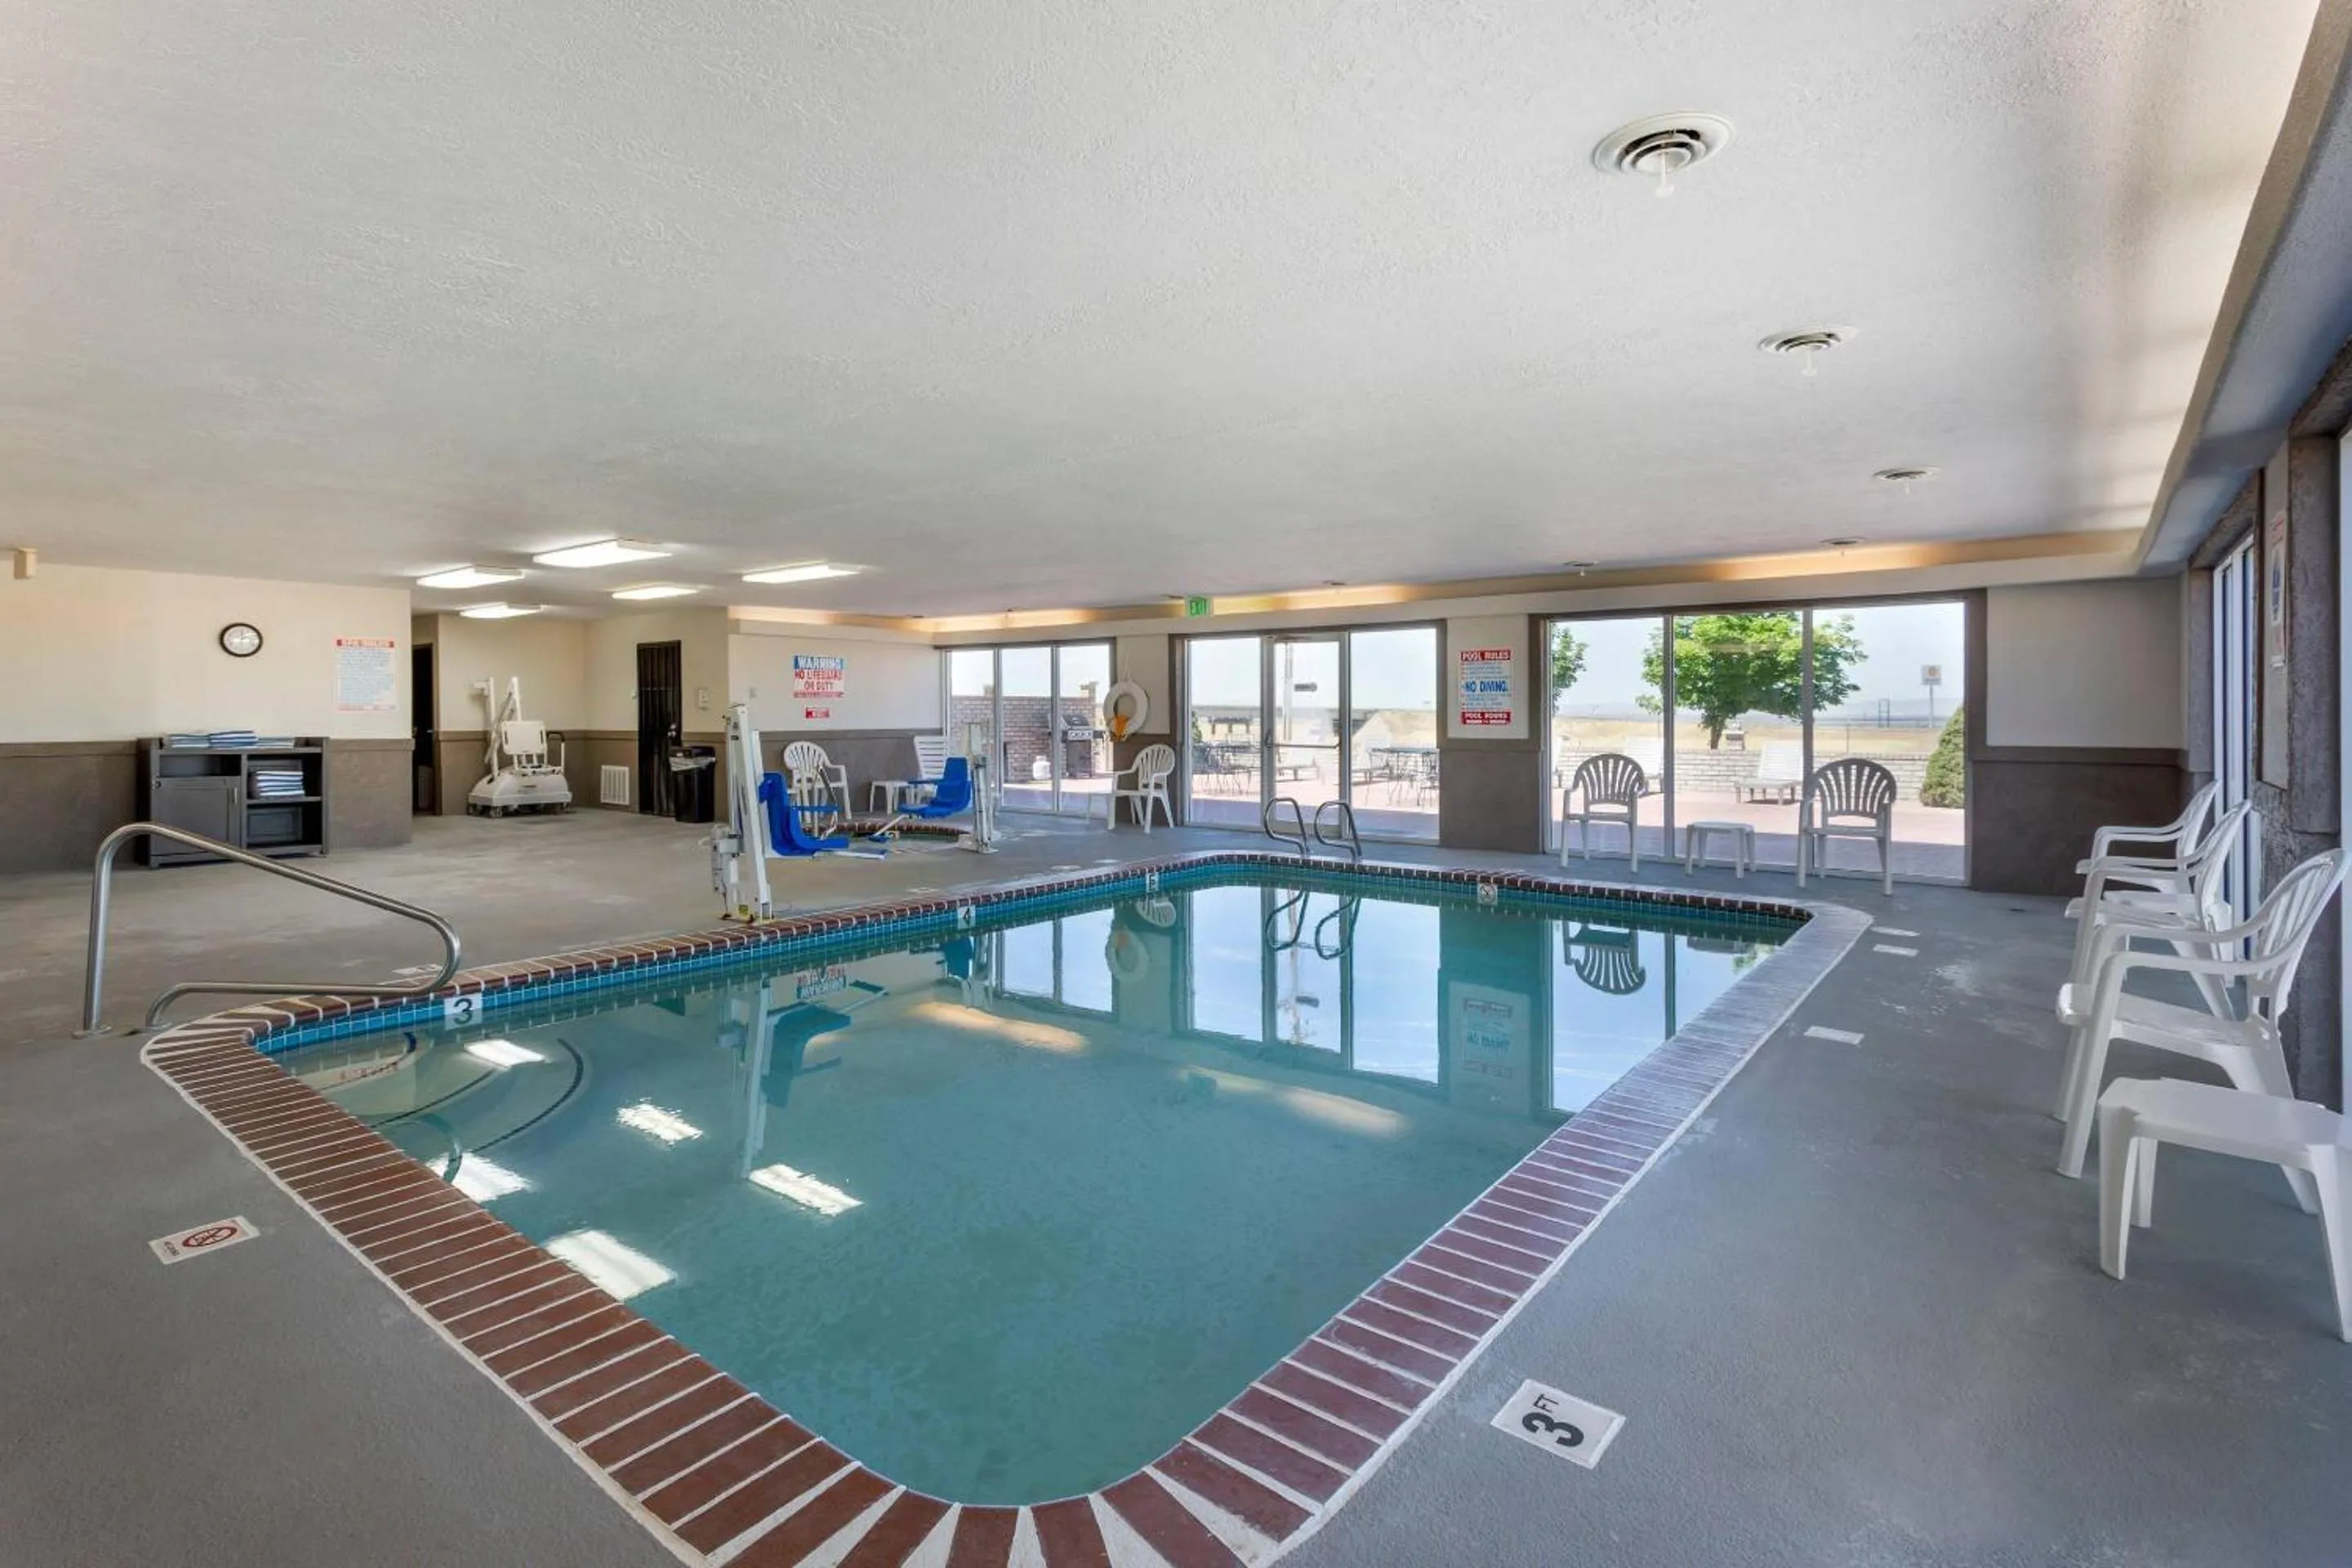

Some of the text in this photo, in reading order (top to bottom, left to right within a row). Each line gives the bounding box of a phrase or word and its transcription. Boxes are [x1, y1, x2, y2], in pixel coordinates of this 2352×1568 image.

[1191, 600, 1206, 615] EXIT
[797, 656, 842, 670] WARNING
[1462, 651, 1509, 662] POOL RULES
[795, 669, 805, 679] NO
[1465, 679, 1477, 693] NO
[454, 998, 472, 1025] 3
[1521, 1393, 1584, 1448] 3 FT
